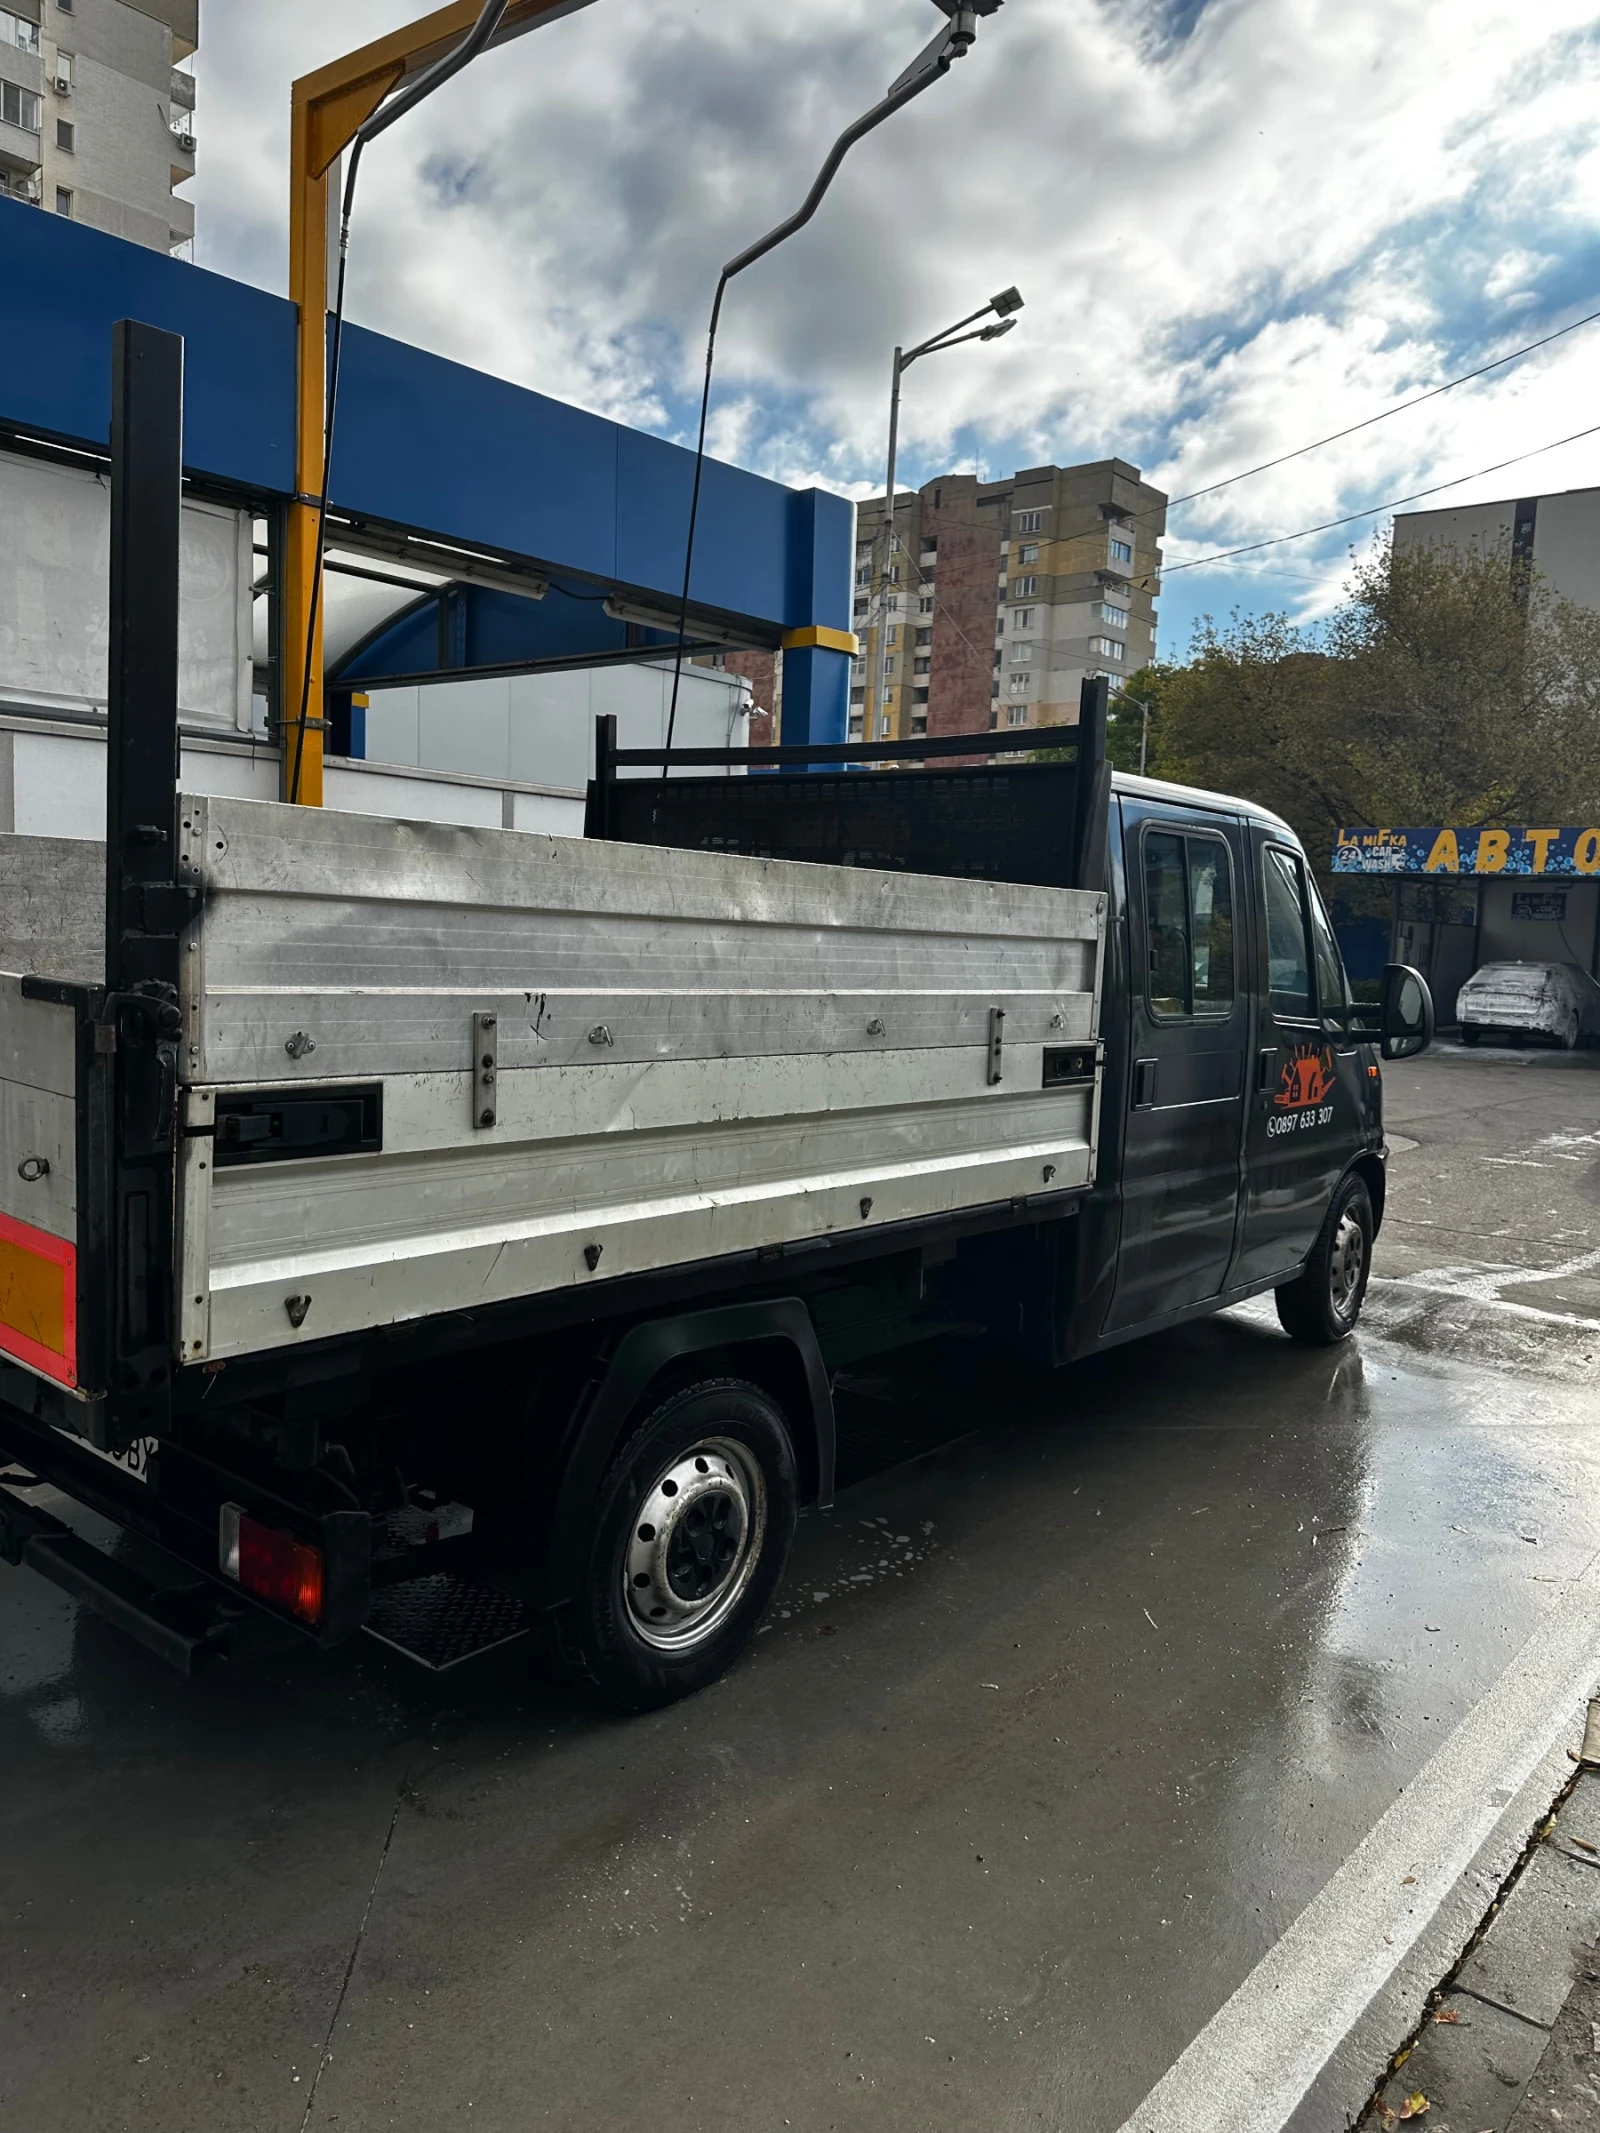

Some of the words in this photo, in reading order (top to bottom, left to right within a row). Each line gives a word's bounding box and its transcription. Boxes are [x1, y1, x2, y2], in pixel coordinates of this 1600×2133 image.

[1340, 850, 1357, 860] 24
[1372, 846, 1392, 857] CAR
[1425, 828, 1600, 873] АВТО
[1362, 859, 1391, 870] WASH
[1275, 1114, 1298, 1134] 0897
[1300, 1110, 1316, 1128] 633
[1318, 1106, 1333, 1125] 307
